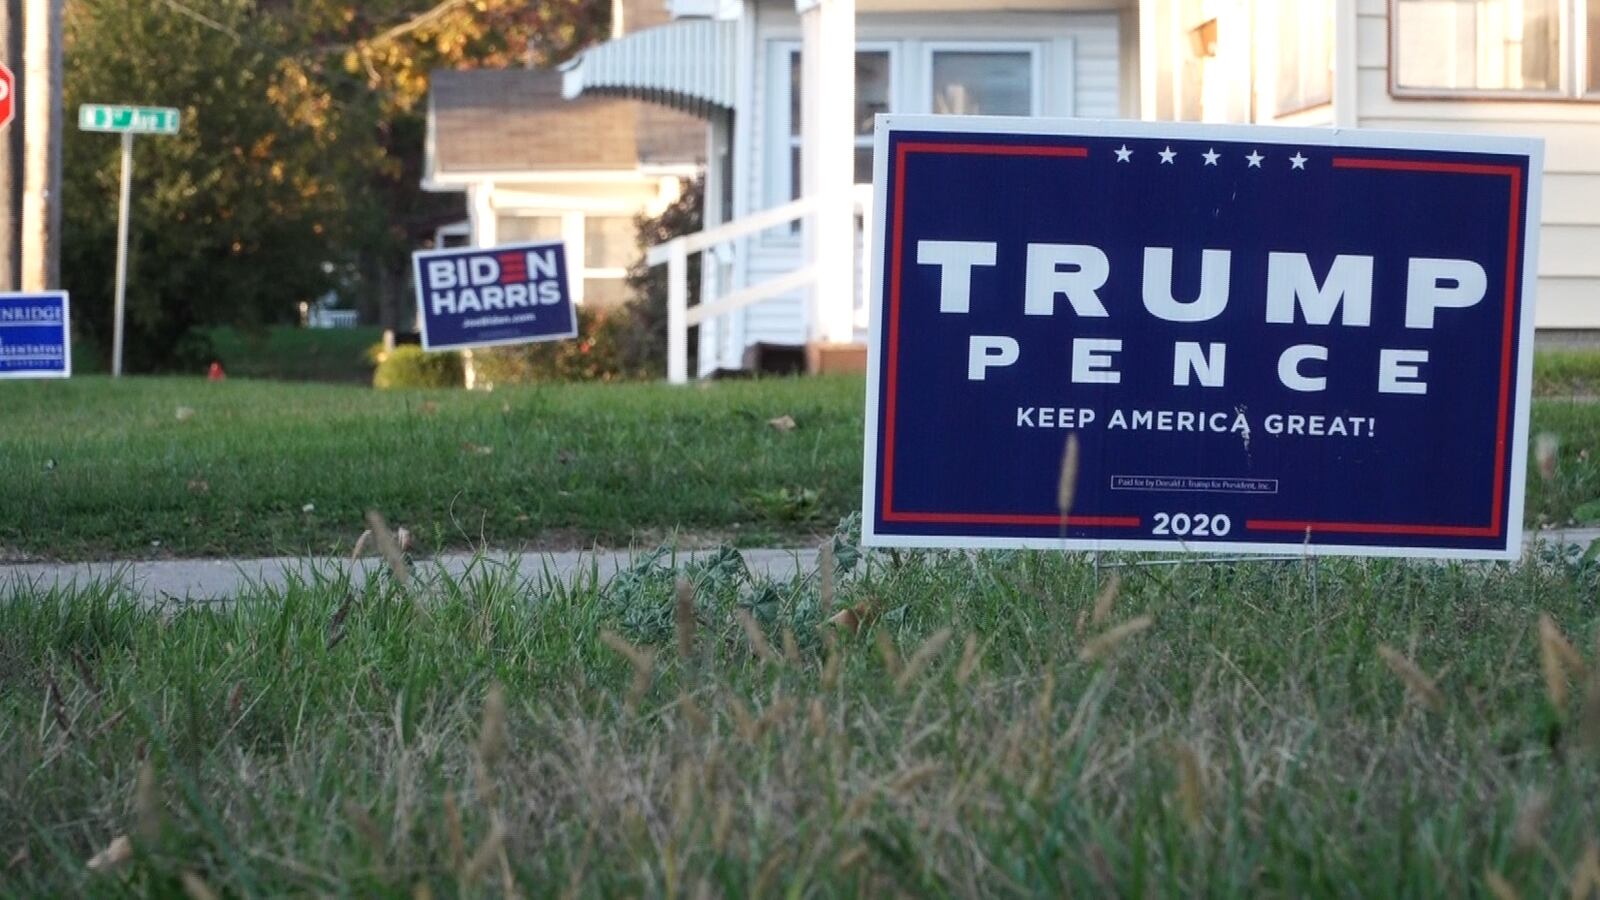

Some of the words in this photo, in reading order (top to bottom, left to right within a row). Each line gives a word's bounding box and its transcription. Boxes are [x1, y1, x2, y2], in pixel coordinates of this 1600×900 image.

[428, 250, 558, 290] BIDEN
[916, 239, 1488, 329] TRUMP
[431, 280, 562, 316] HARRIS
[967, 335, 1430, 395] PENCE
[1016, 407, 1096, 429] KEEP
[1107, 409, 1251, 433] AMERICA
[1264, 414, 1376, 438] GREAT!
[1118, 478, 1133, 486] Paid
[1134, 478, 1144, 486] for
[1145, 479, 1154, 489] by
[1155, 479, 1181, 487] Donald
[1188, 480, 1211, 490] Trump
[1151, 512, 1231, 537] 2020
